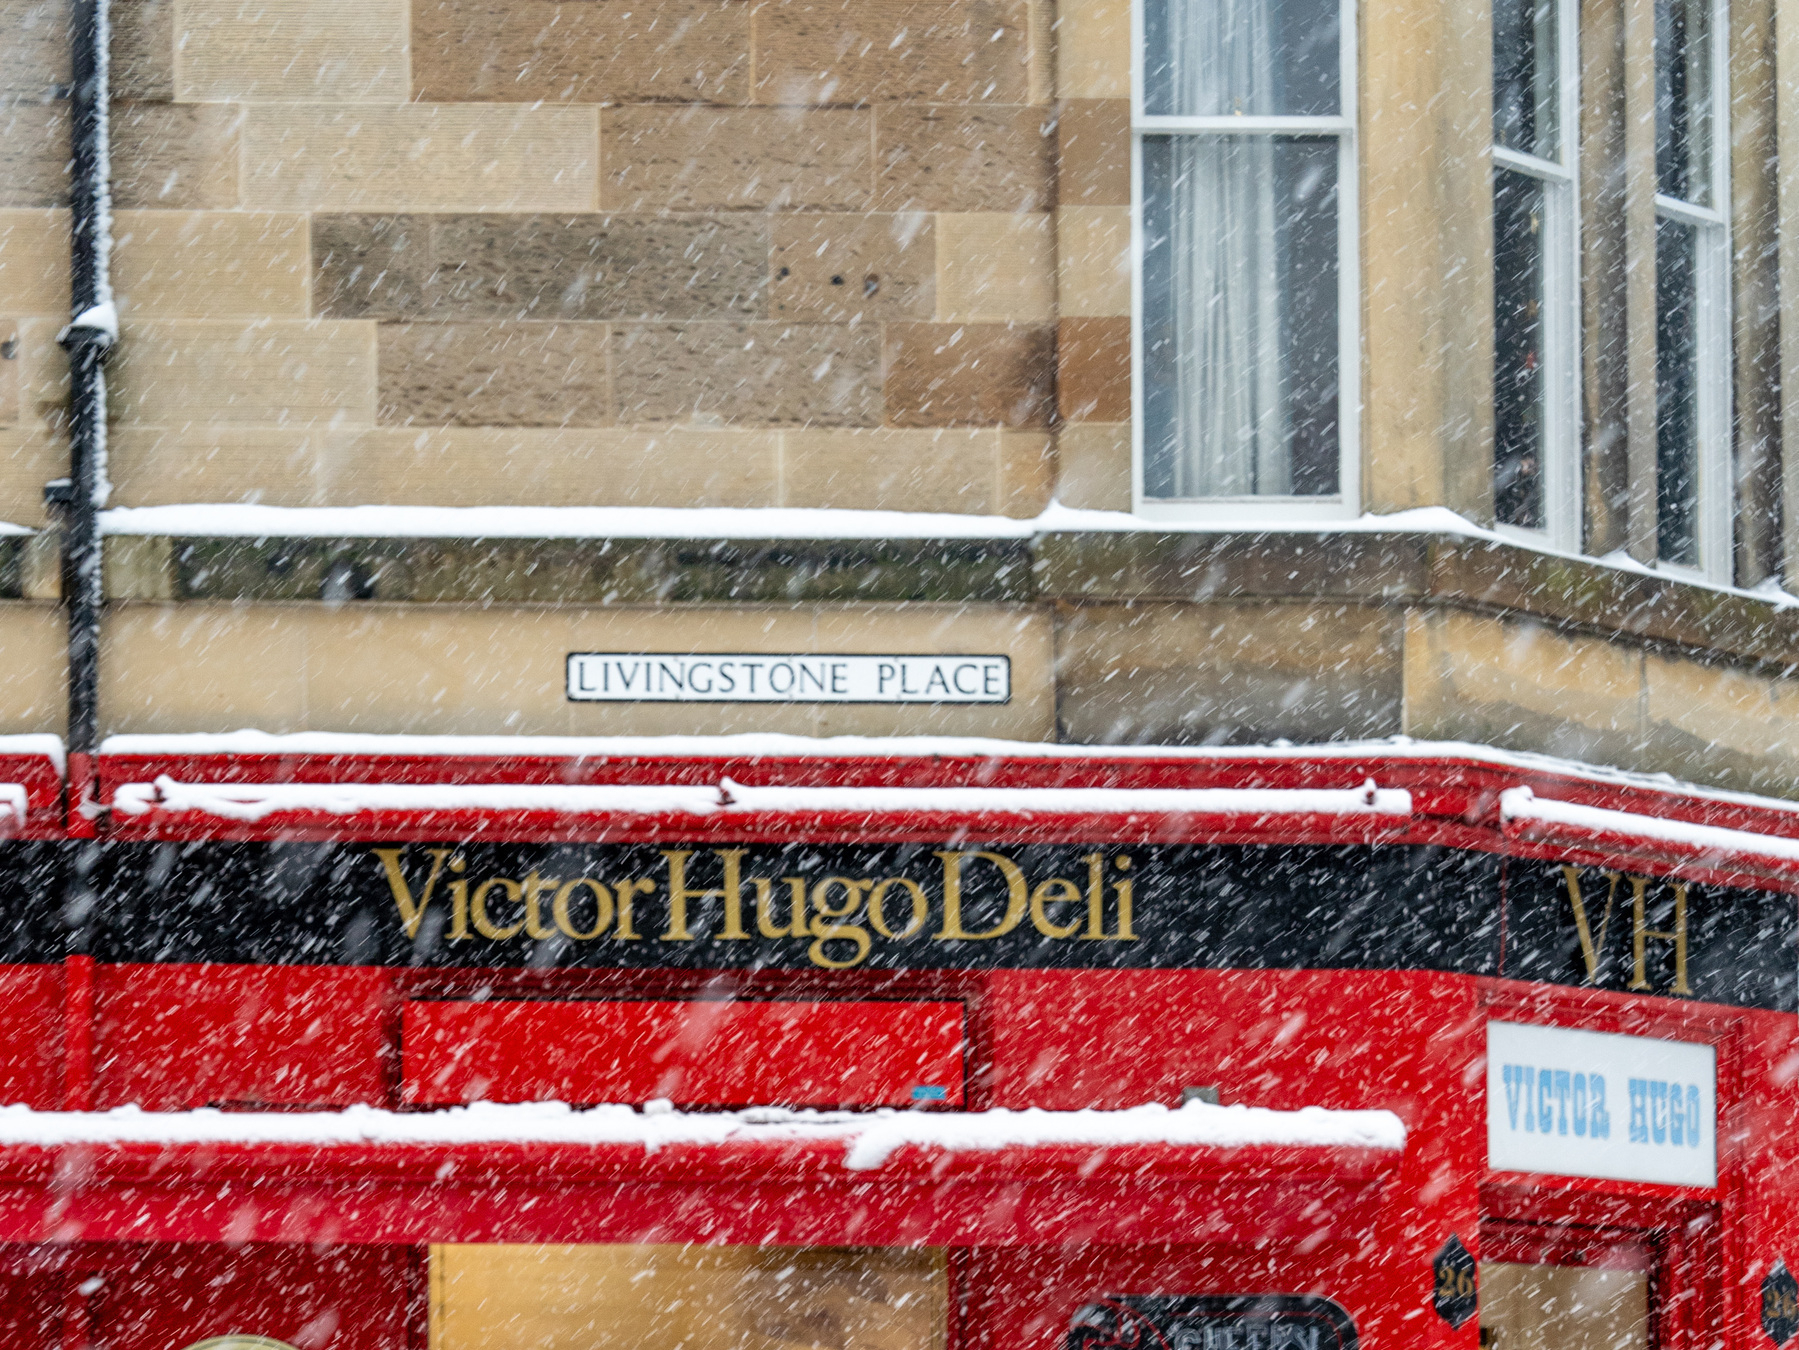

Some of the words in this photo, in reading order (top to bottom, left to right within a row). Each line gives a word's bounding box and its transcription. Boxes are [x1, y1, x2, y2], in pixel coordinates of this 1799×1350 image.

[577, 661, 849, 694] LIVINGSTONE
[876, 663, 1001, 695] PLACE
[1561, 864, 1694, 996] VH
[1502, 1063, 1610, 1141] VICTOR
[1627, 1077, 1701, 1149] HUGO
[1437, 1265, 1474, 1299] 26
